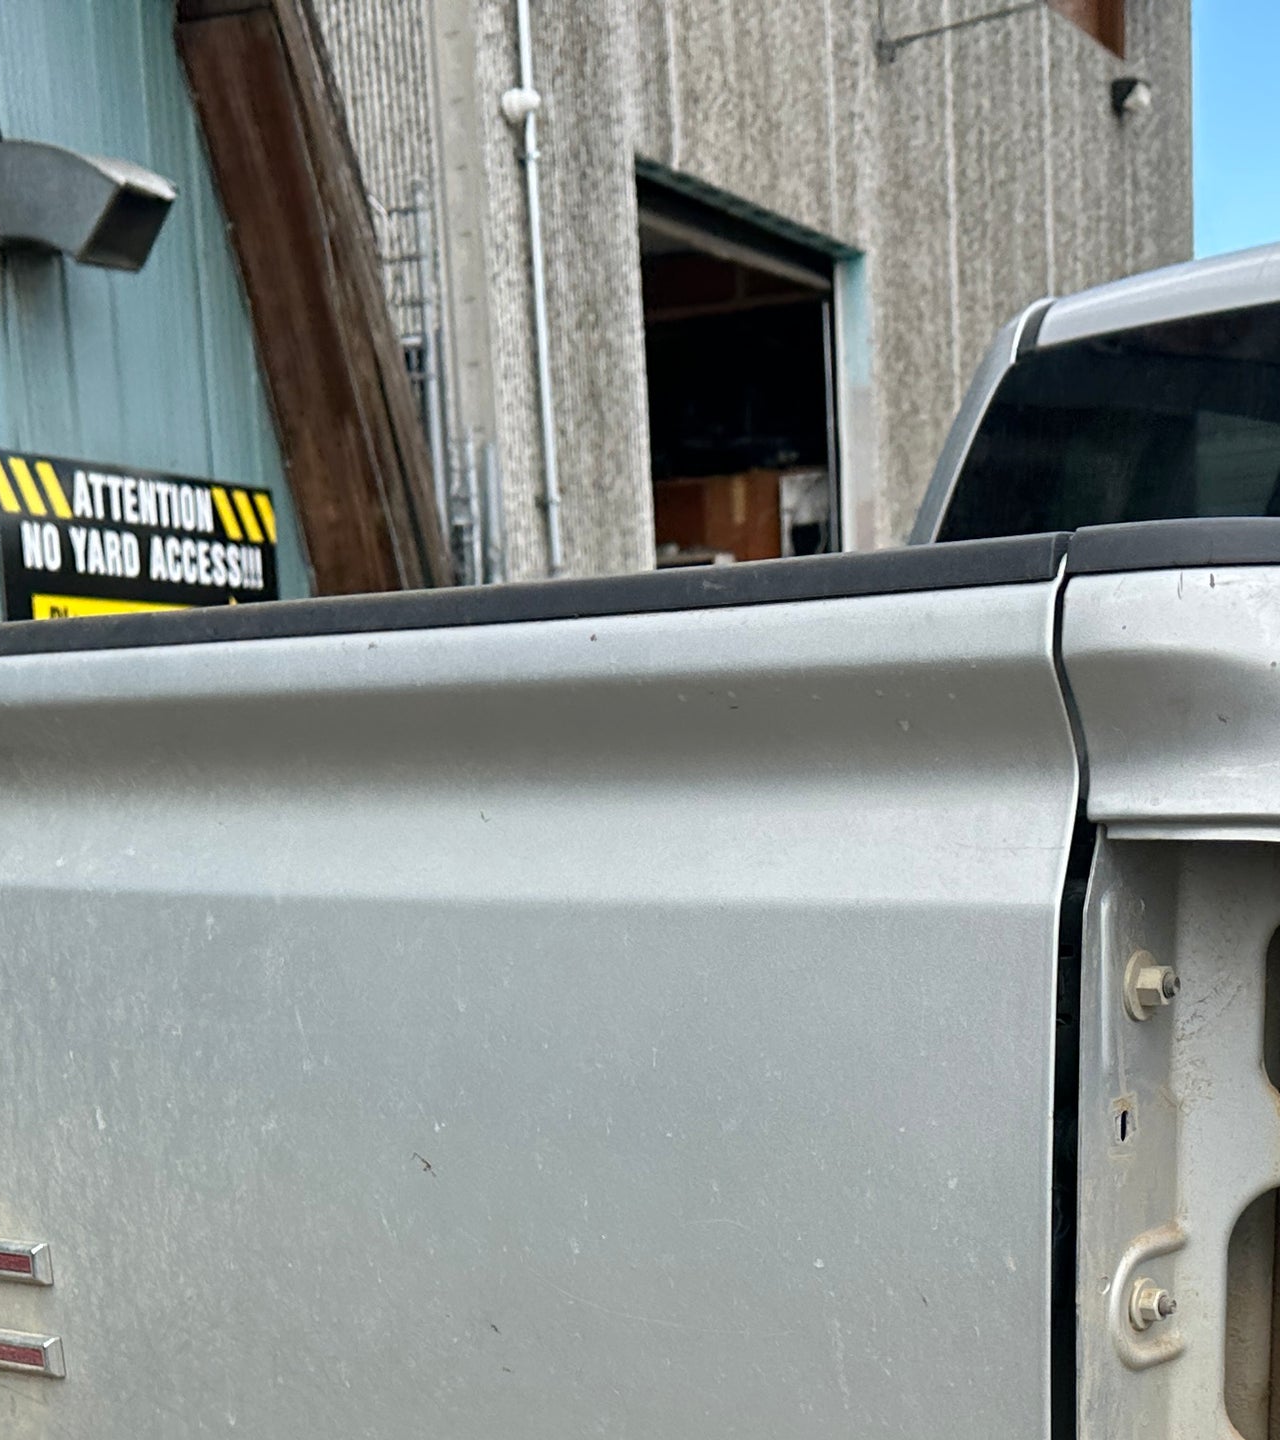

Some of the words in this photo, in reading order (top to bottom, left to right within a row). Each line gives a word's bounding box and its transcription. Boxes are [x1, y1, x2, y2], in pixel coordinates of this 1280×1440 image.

[72, 470, 215, 532] ATTENTION
[21, 520, 62, 571] NO
[69, 526, 141, 578] YARD
[149, 534, 264, 590] ACCESS!!!
